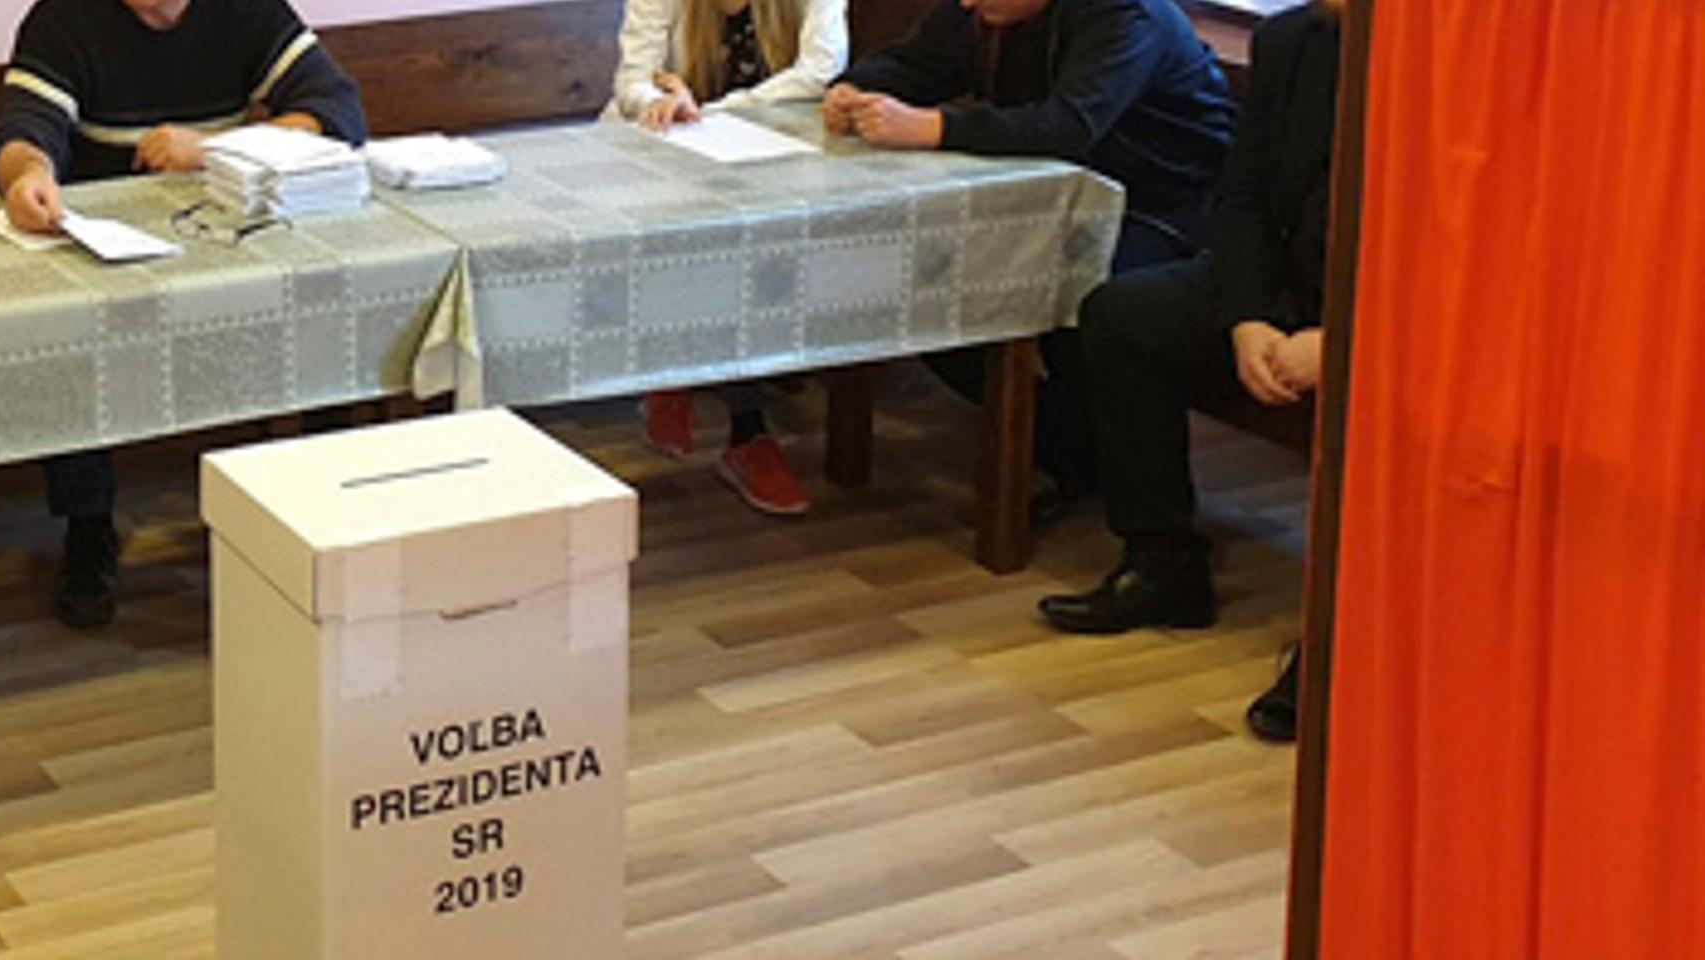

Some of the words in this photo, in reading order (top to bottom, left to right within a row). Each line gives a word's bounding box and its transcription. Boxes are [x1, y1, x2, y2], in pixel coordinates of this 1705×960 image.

[351, 746, 601, 829] PREZIDENTA
[452, 818, 504, 858] SR
[435, 866, 523, 912] 2019
